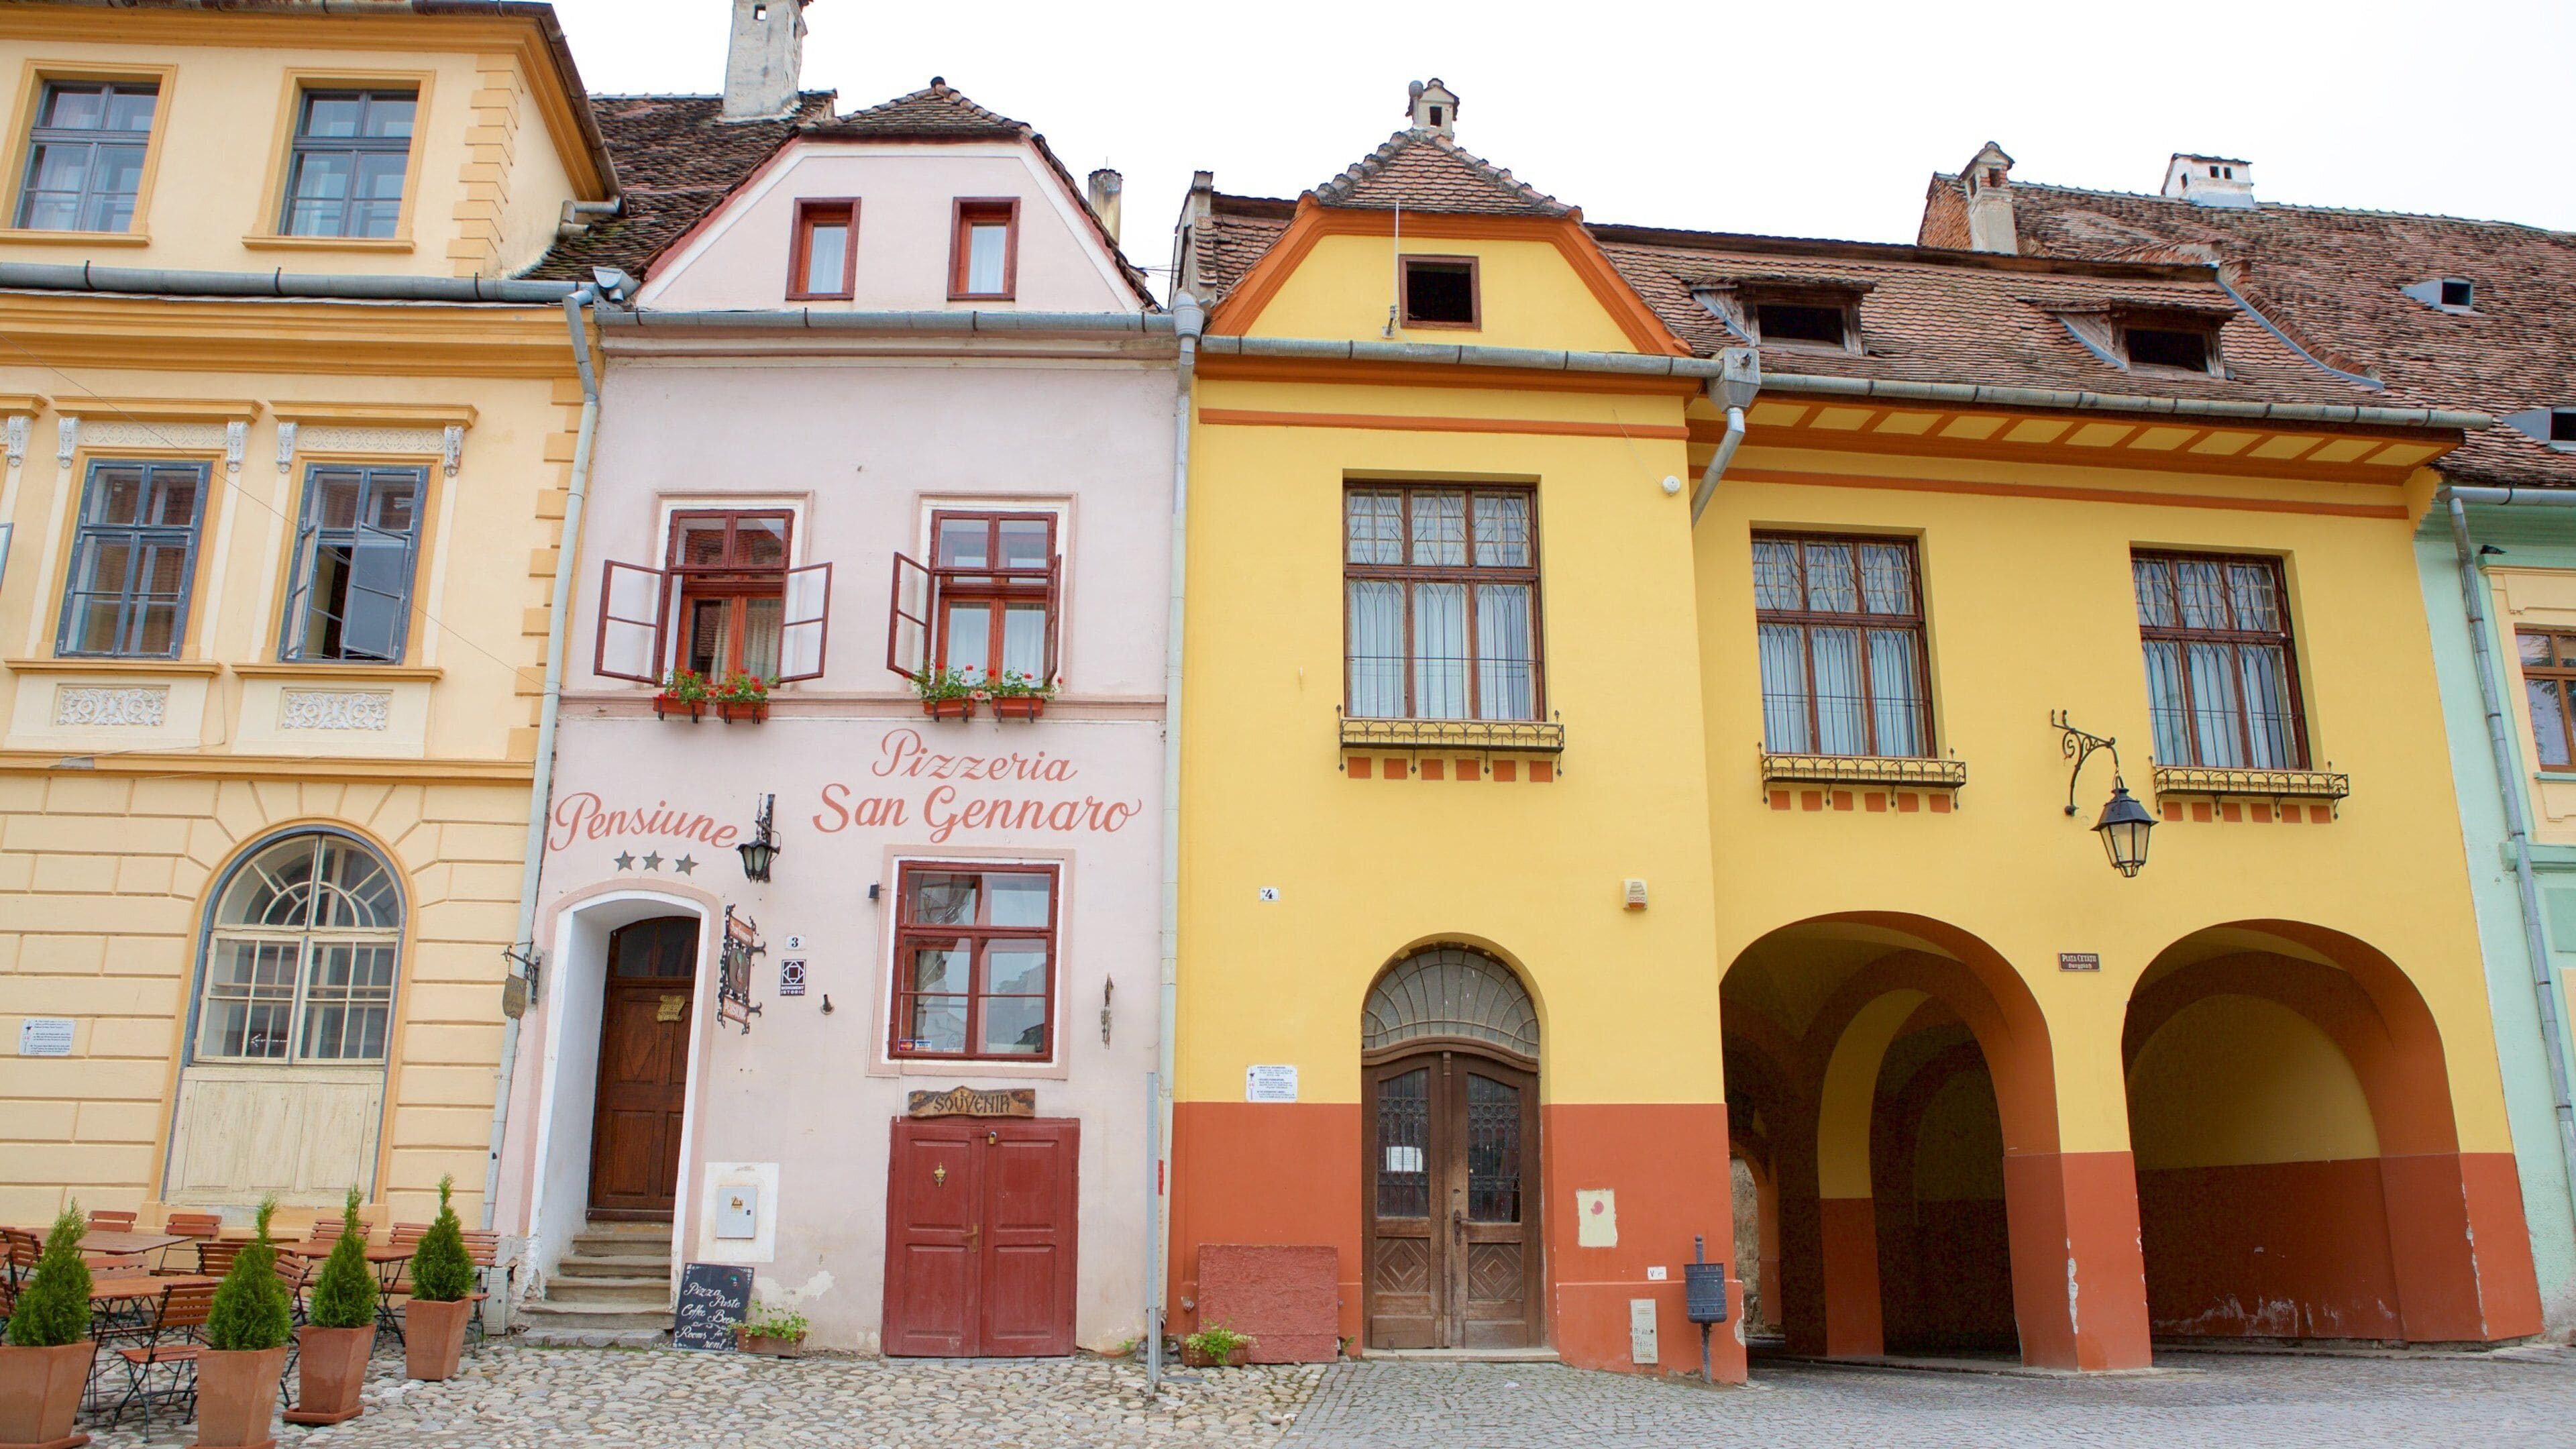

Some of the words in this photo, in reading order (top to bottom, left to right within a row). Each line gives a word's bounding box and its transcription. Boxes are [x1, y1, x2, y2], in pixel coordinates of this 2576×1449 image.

[872, 729, 1078, 782] Pizzeria
[549, 792, 739, 851] Pensiune
[812, 783, 908, 833] San
[923, 785, 1142, 844] Gennaro
[1265, 889, 1273, 900] 4
[792, 937, 798, 947] 3
[933, 1094, 1010, 1114] SOUVENIR
[683, 1282, 722, 1297] Pizza
[681, 1303, 706, 1320] Coffee
[675, 1325, 707, 1340] Rooms
[710, 1329, 723, 1340] for
